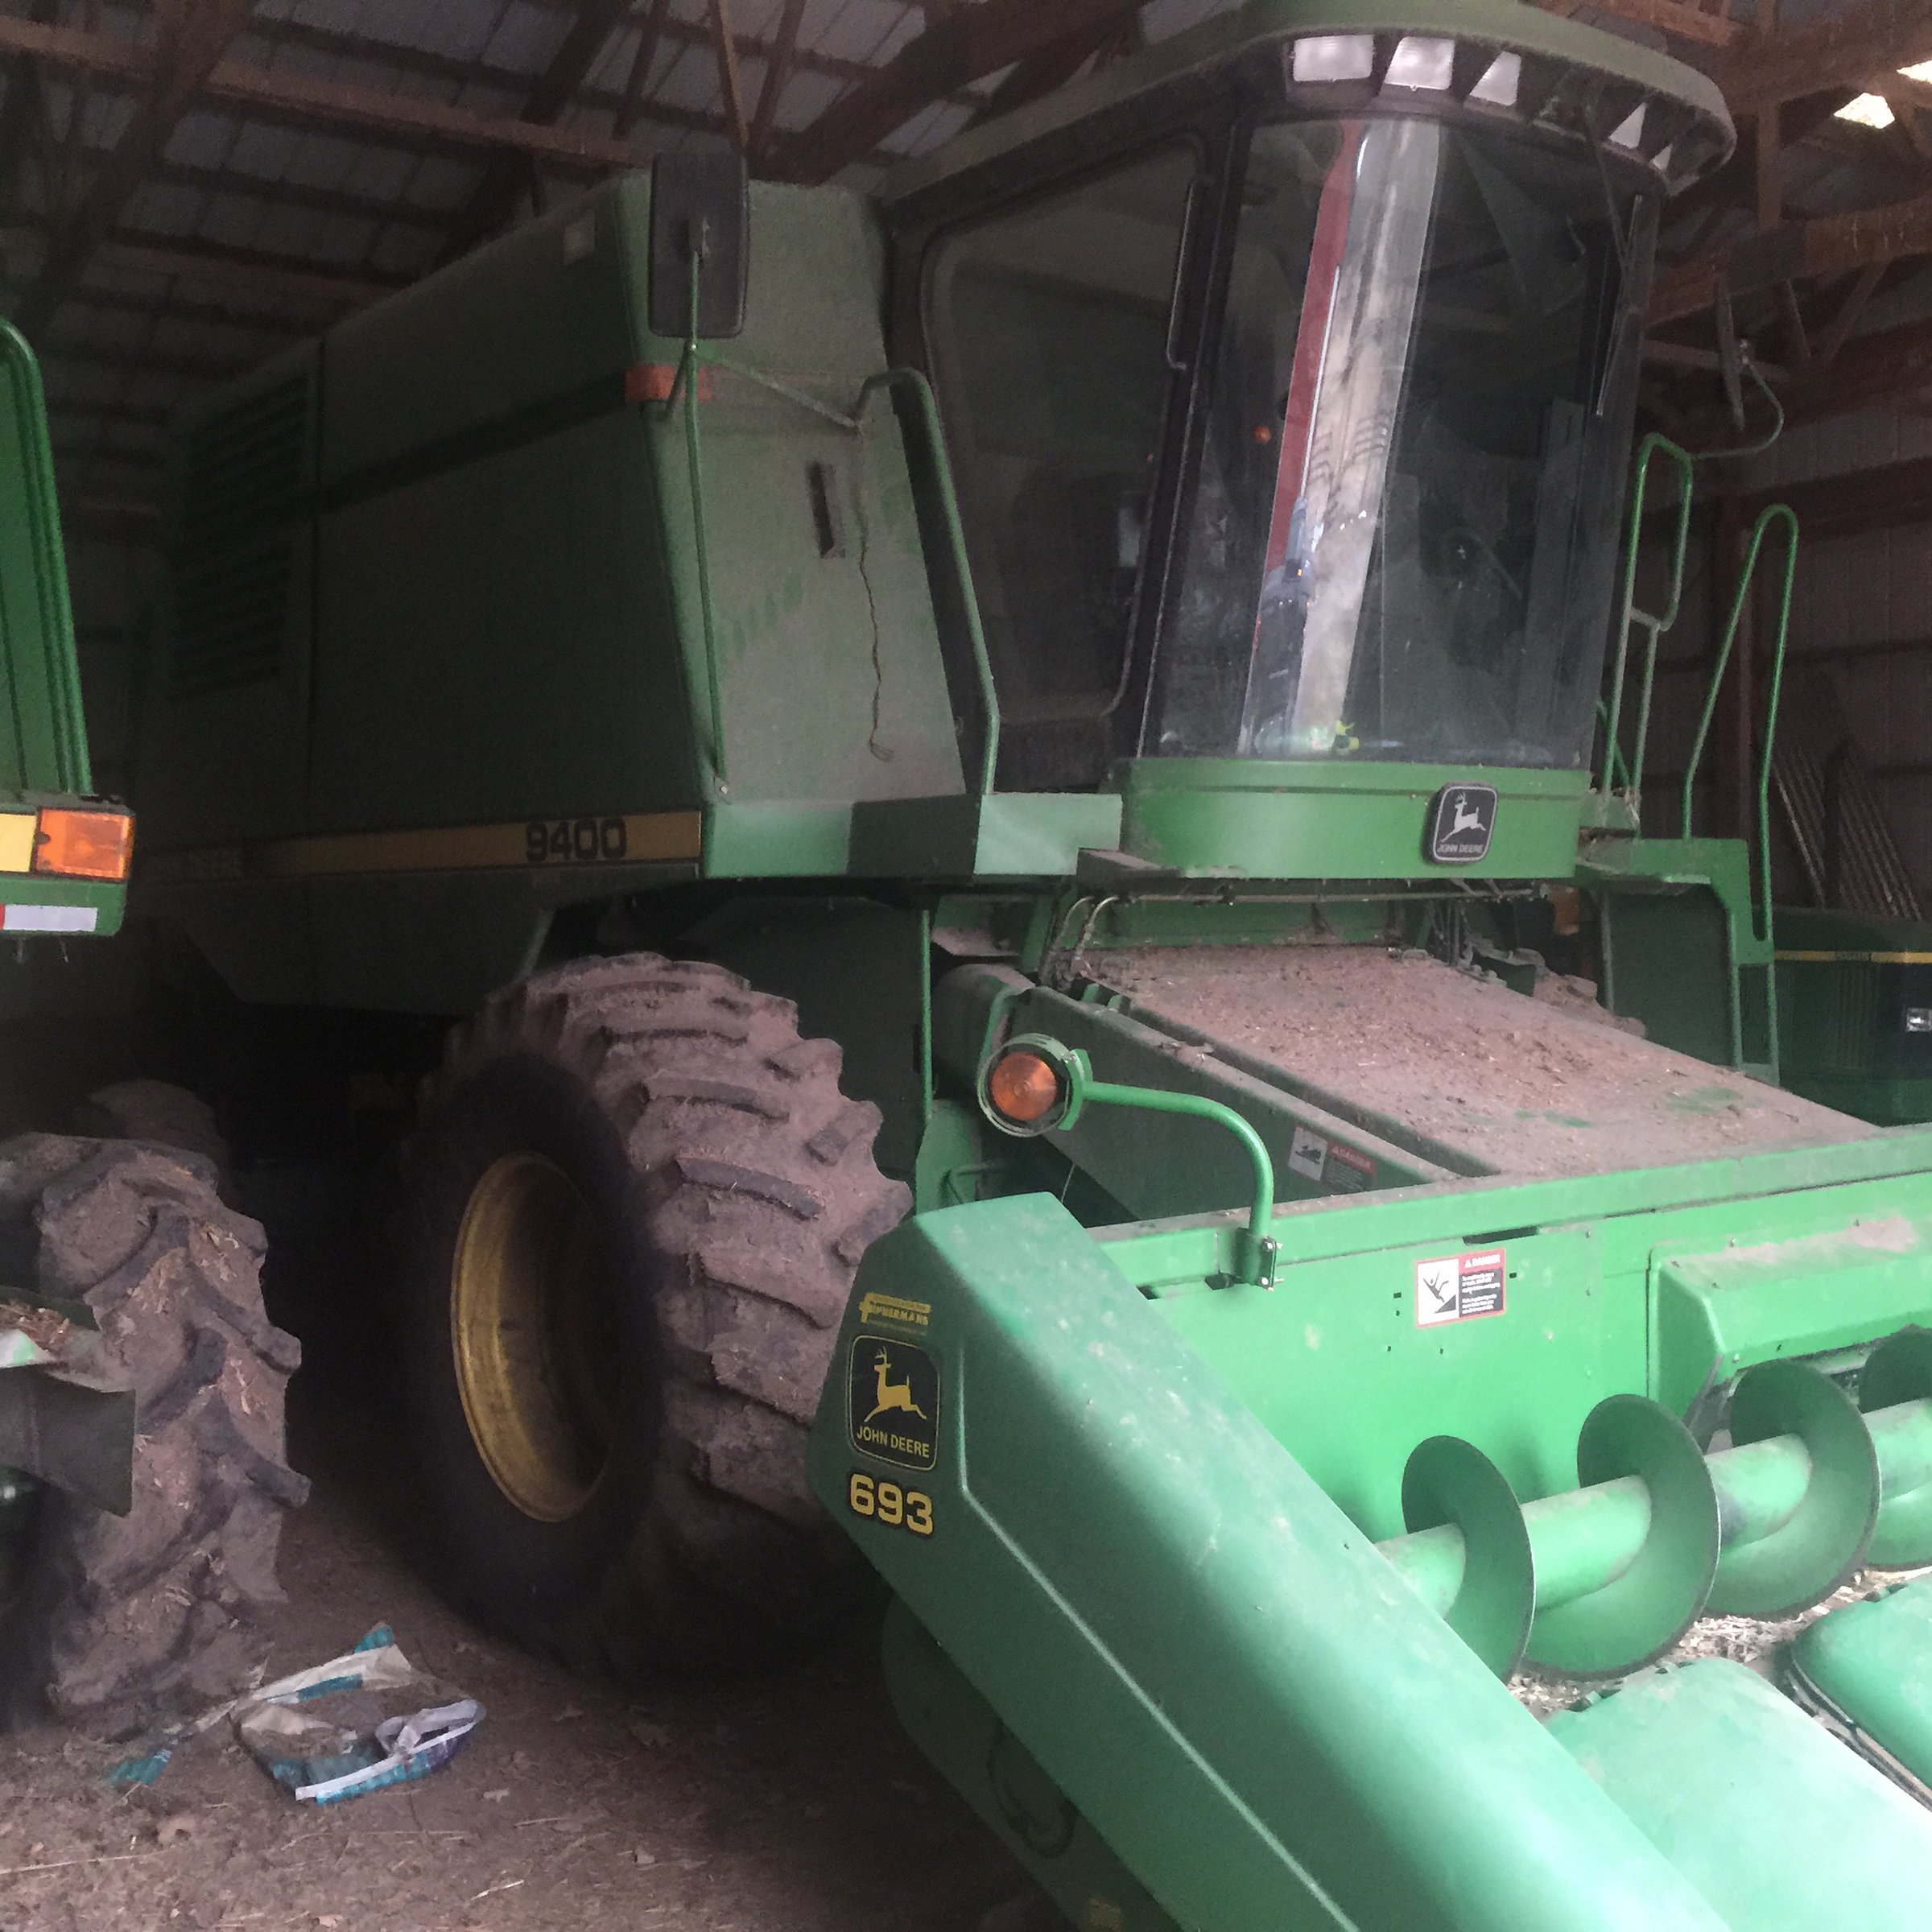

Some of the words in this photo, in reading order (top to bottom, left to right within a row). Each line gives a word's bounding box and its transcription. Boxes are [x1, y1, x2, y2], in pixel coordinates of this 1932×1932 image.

[526, 816, 626, 863] 9400
[1437, 844, 1458, 853] JOHN
[1459, 844, 1484, 853] DEERE
[856, 1424, 889, 1447] JOHN
[890, 1433, 931, 1459] DEERE
[850, 1472, 934, 1536] 693
